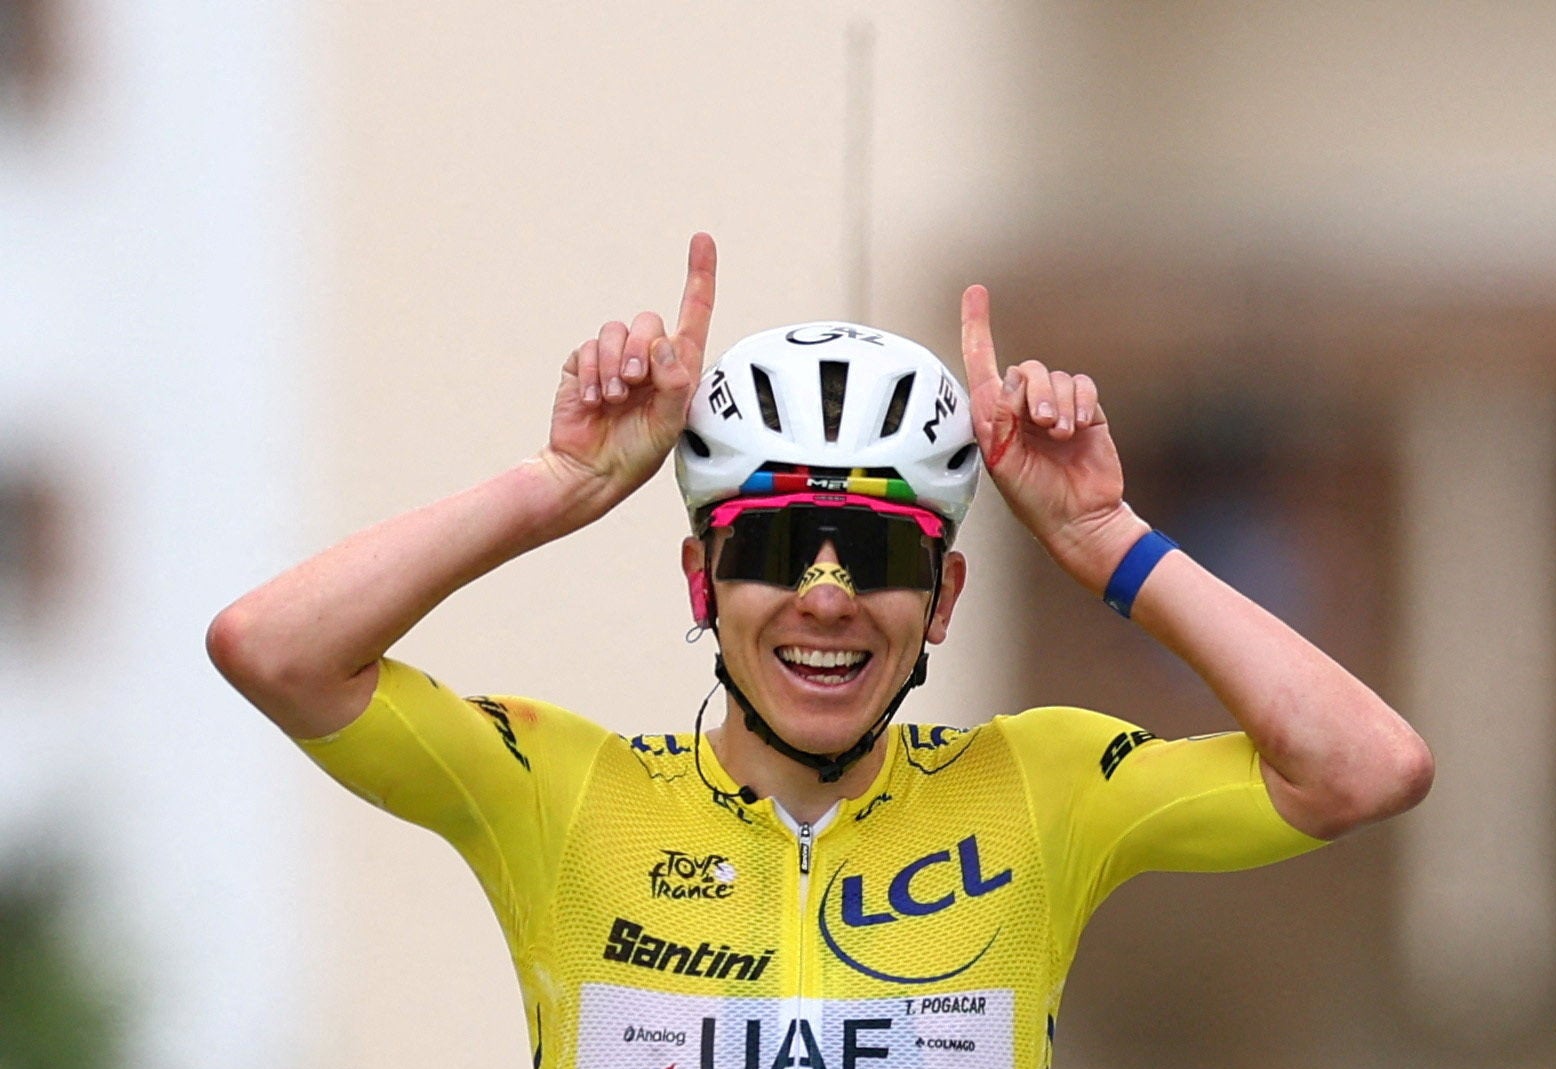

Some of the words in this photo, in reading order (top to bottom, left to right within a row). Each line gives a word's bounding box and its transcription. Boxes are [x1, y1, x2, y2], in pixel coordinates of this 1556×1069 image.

[841, 835, 1013, 927] LCL
[603, 917, 775, 980] Santini
[905, 1000, 916, 1015] T.
[921, 996, 986, 1014] POGACAR
[636, 1027, 686, 1046] Analog
[927, 1039, 975, 1052] COLNAGO
